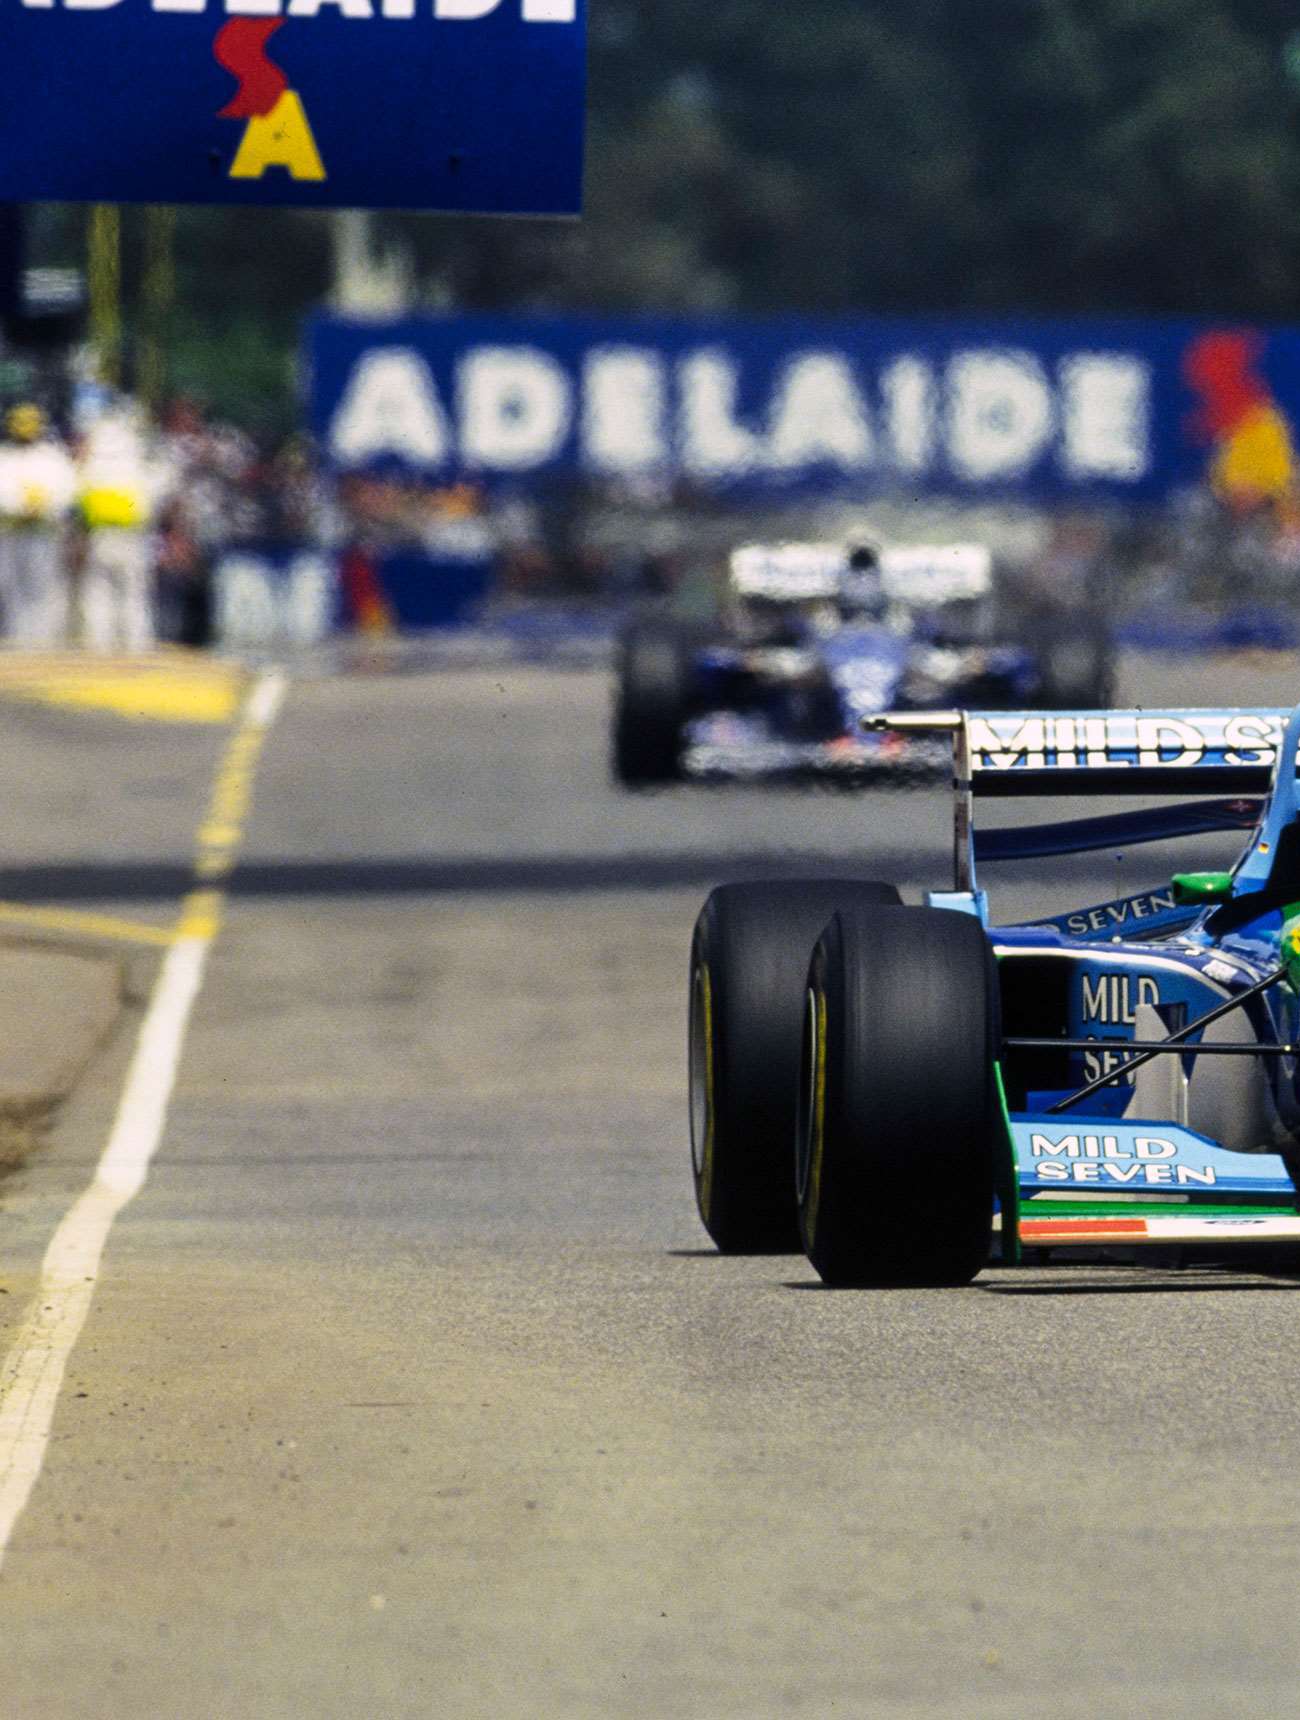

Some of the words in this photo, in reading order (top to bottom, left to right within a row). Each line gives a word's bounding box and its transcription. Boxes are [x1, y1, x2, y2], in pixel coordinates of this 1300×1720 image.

[332, 343, 1150, 481] ADELAIDE
[970, 716, 1204, 767] MILD
[1067, 890, 1176, 935] SEVEN
[1081, 973, 1160, 1023] MILD
[1030, 1134, 1177, 1159] MILD
[1034, 1160, 1217, 1185] SEVEN
